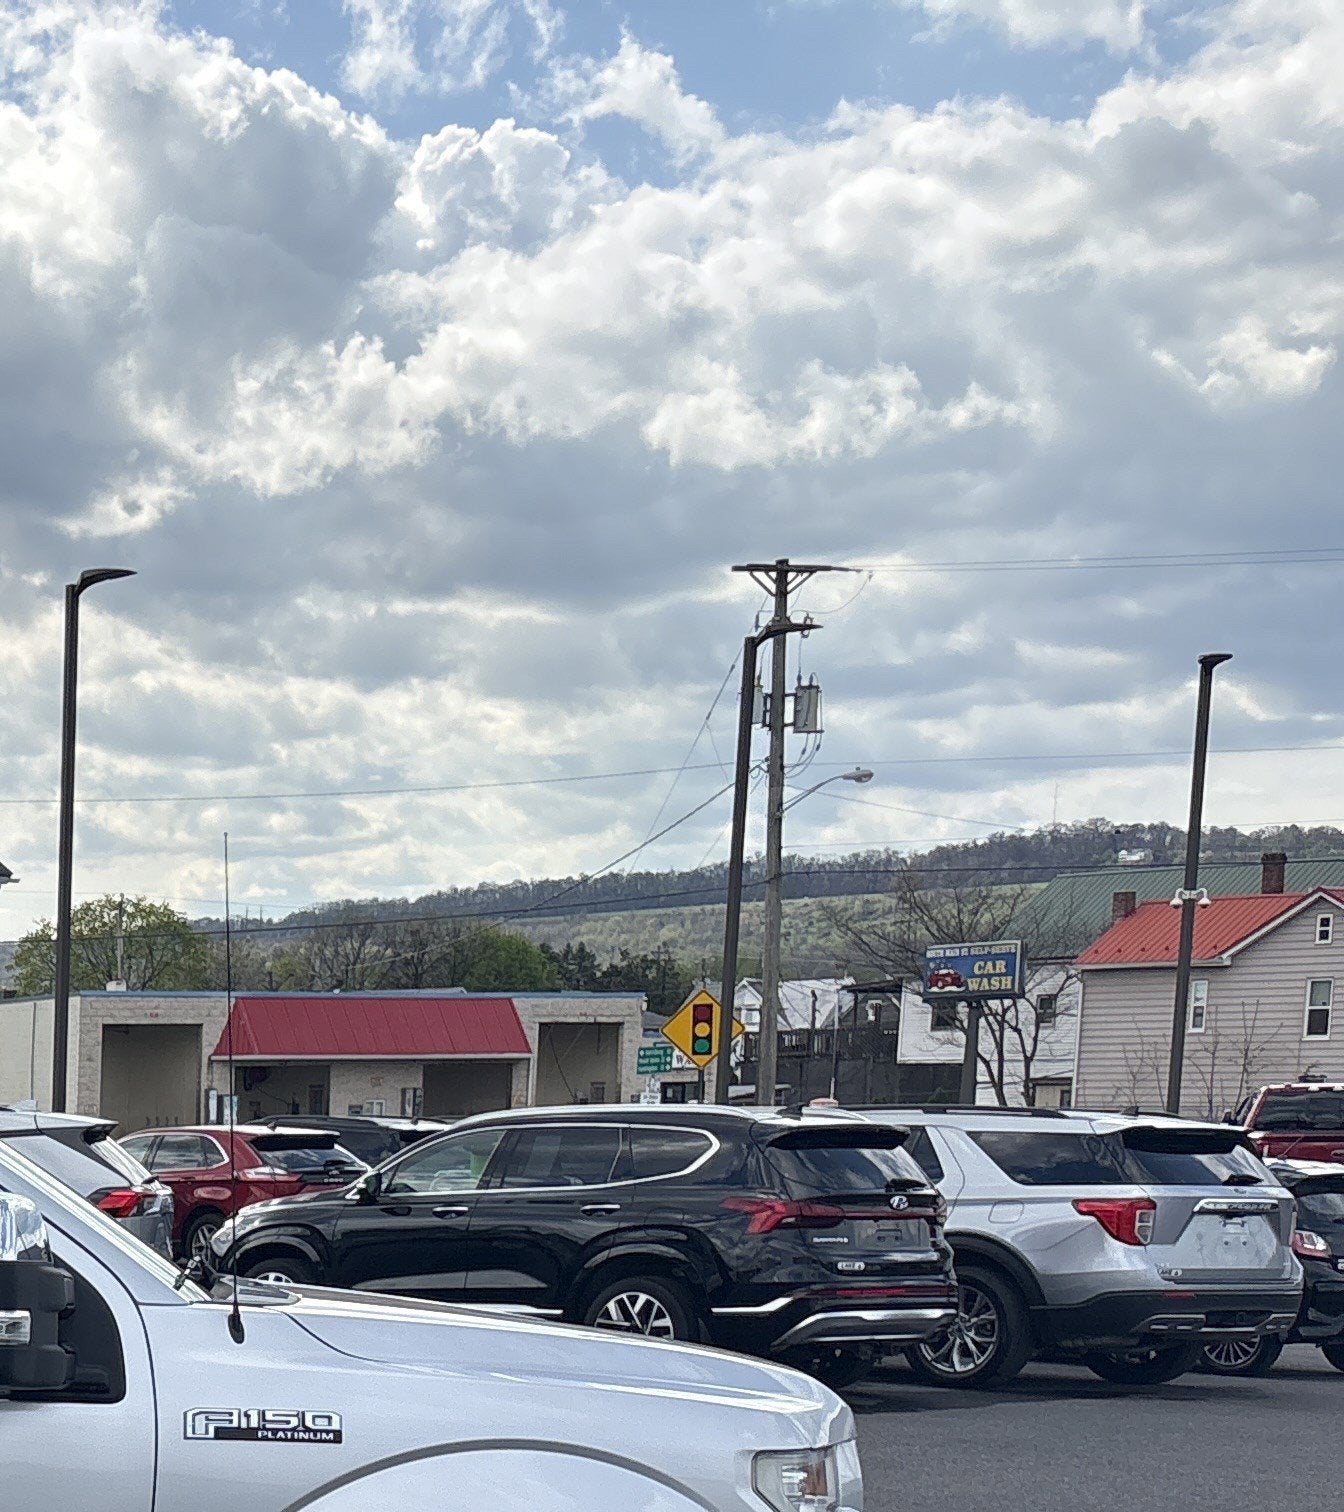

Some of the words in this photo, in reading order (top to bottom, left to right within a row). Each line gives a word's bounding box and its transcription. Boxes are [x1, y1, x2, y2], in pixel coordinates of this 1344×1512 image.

[973, 960, 1006, 975] CAR
[967, 976, 1013, 991] WASH
[257, 1430, 334, 1441] PLATINUM
